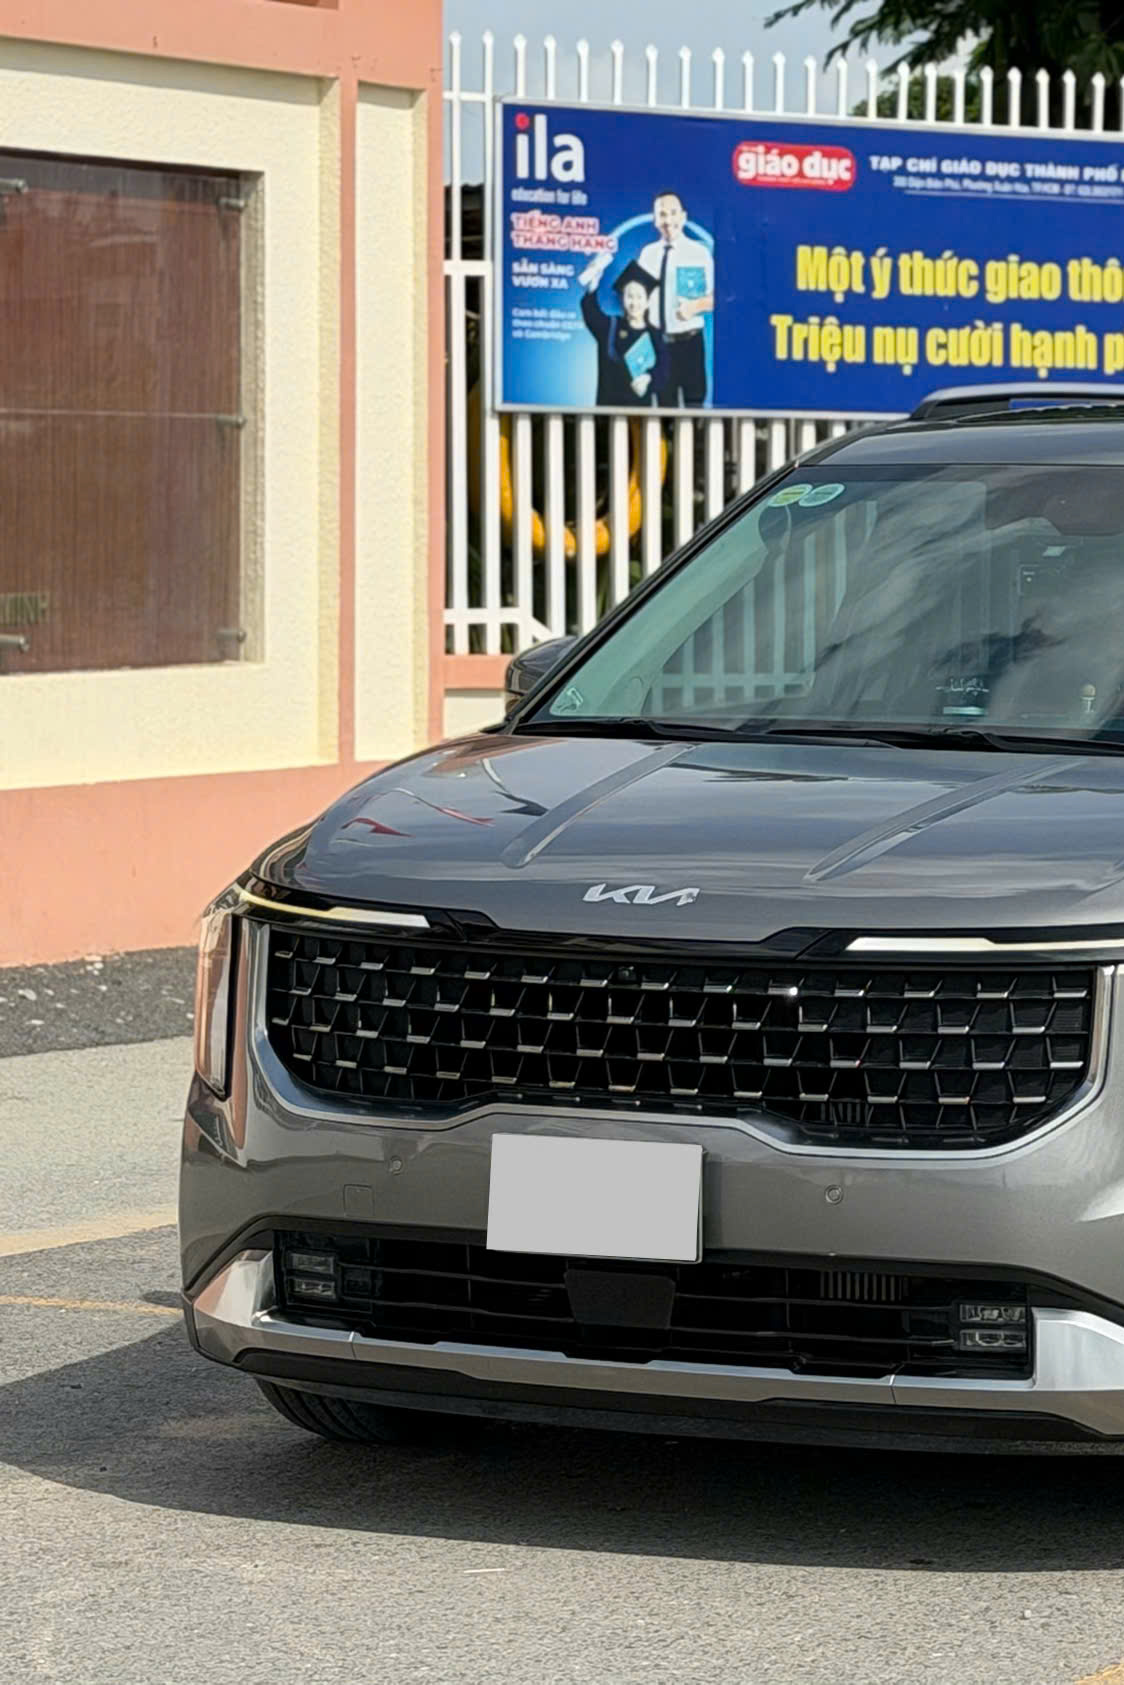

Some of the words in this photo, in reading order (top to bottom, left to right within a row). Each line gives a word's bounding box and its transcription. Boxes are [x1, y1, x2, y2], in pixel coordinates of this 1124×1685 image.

[515, 112, 585, 183] ila
[737, 145, 800, 179] giáo
[802, 151, 852, 185] dục
[869, 155, 903, 173] TẠP
[906, 156, 938, 173] CHÍ
[941, 157, 982, 175] GIÁO
[985, 160, 1021, 178] DỤC
[1024, 161, 1080, 181] THÀNH
[1083, 163, 1119, 183] PHỐ
[511, 209, 561, 231] TIẾNG
[561, 216, 600, 234] ANH
[568, 234, 618, 256] HẠNG
[550, 277, 570, 289] XA
[796, 245, 866, 303] Một
[870, 247, 892, 299] ý
[898, 249, 979, 298] thức
[985, 254, 1062, 304] giao
[770, 314, 867, 373] Triệu
[872, 324, 919, 376] nụ
[925, 318, 1004, 368] cười
[1010, 323, 1098, 379] hạnh
[582, 882, 700, 907] KIA
